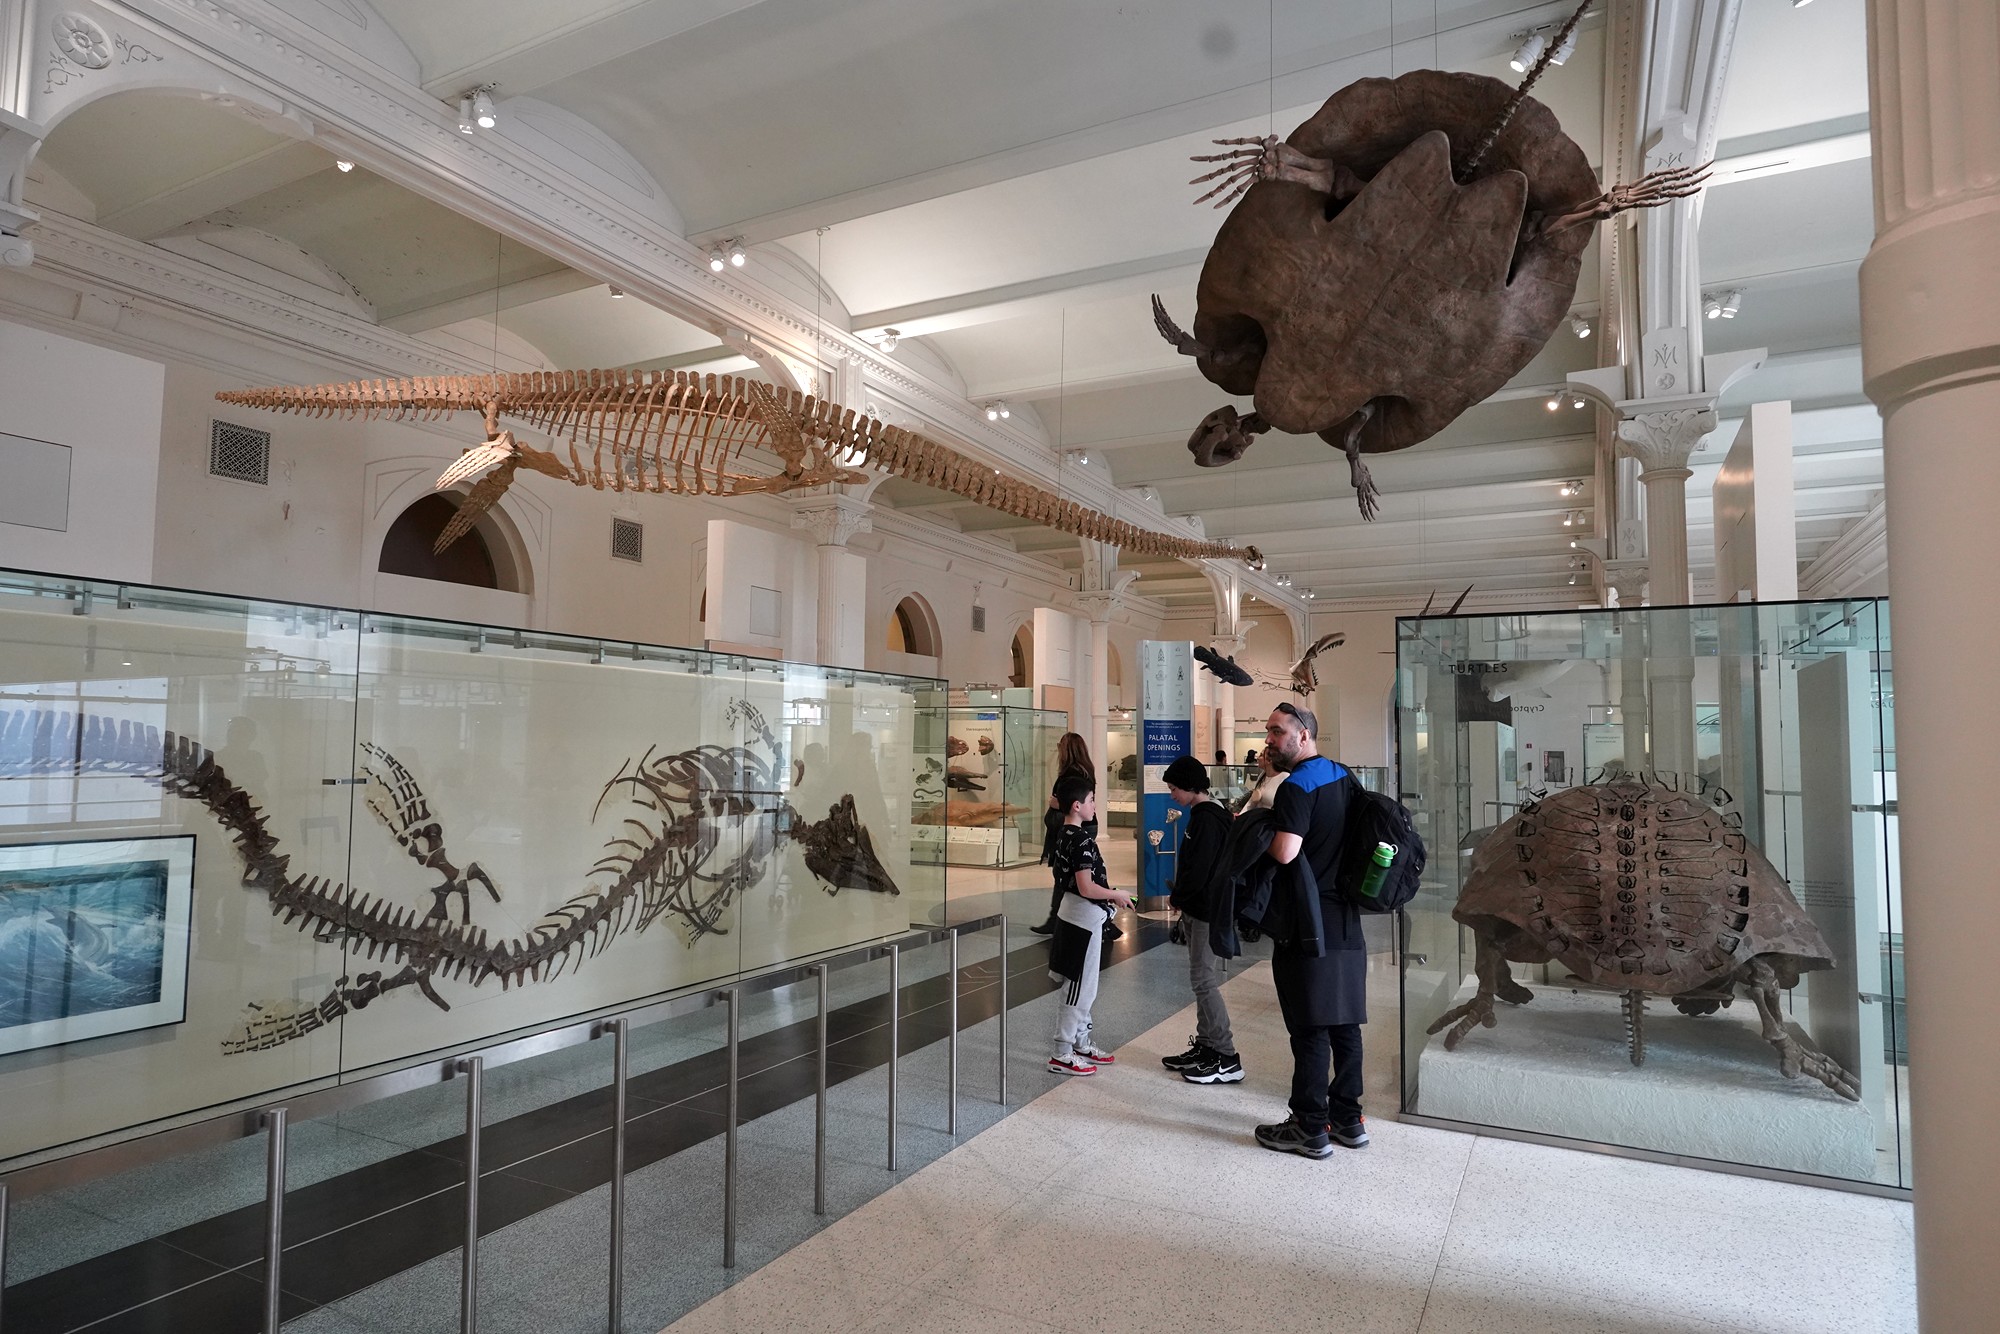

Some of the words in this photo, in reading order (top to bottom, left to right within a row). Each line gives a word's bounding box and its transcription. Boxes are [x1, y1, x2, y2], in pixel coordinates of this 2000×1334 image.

[1448, 663, 1508, 674] TURTLES
[1148, 734, 1178, 742] PALATAL
[1147, 744, 1181, 752] OPENINGS
